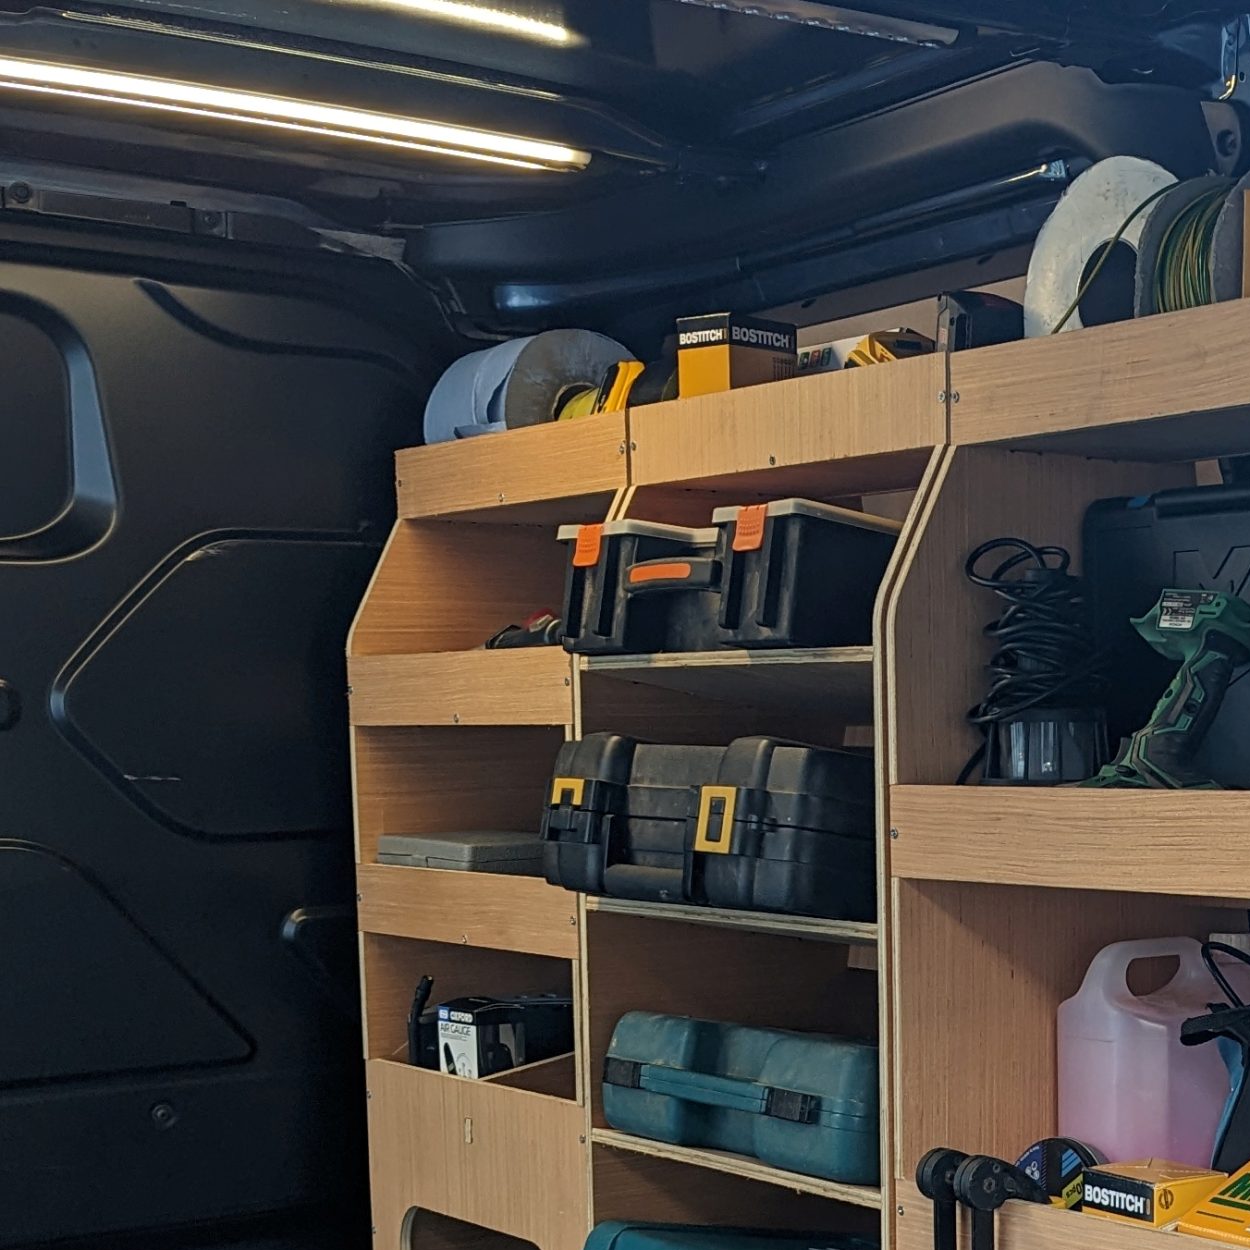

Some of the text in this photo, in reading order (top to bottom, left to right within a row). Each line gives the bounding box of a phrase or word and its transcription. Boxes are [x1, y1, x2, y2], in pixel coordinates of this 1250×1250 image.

[679, 328, 722, 345] BOSTITCH
[732, 326, 789, 348] BOSTITCH
[1084, 1184, 1144, 1214] BOSTITCH
